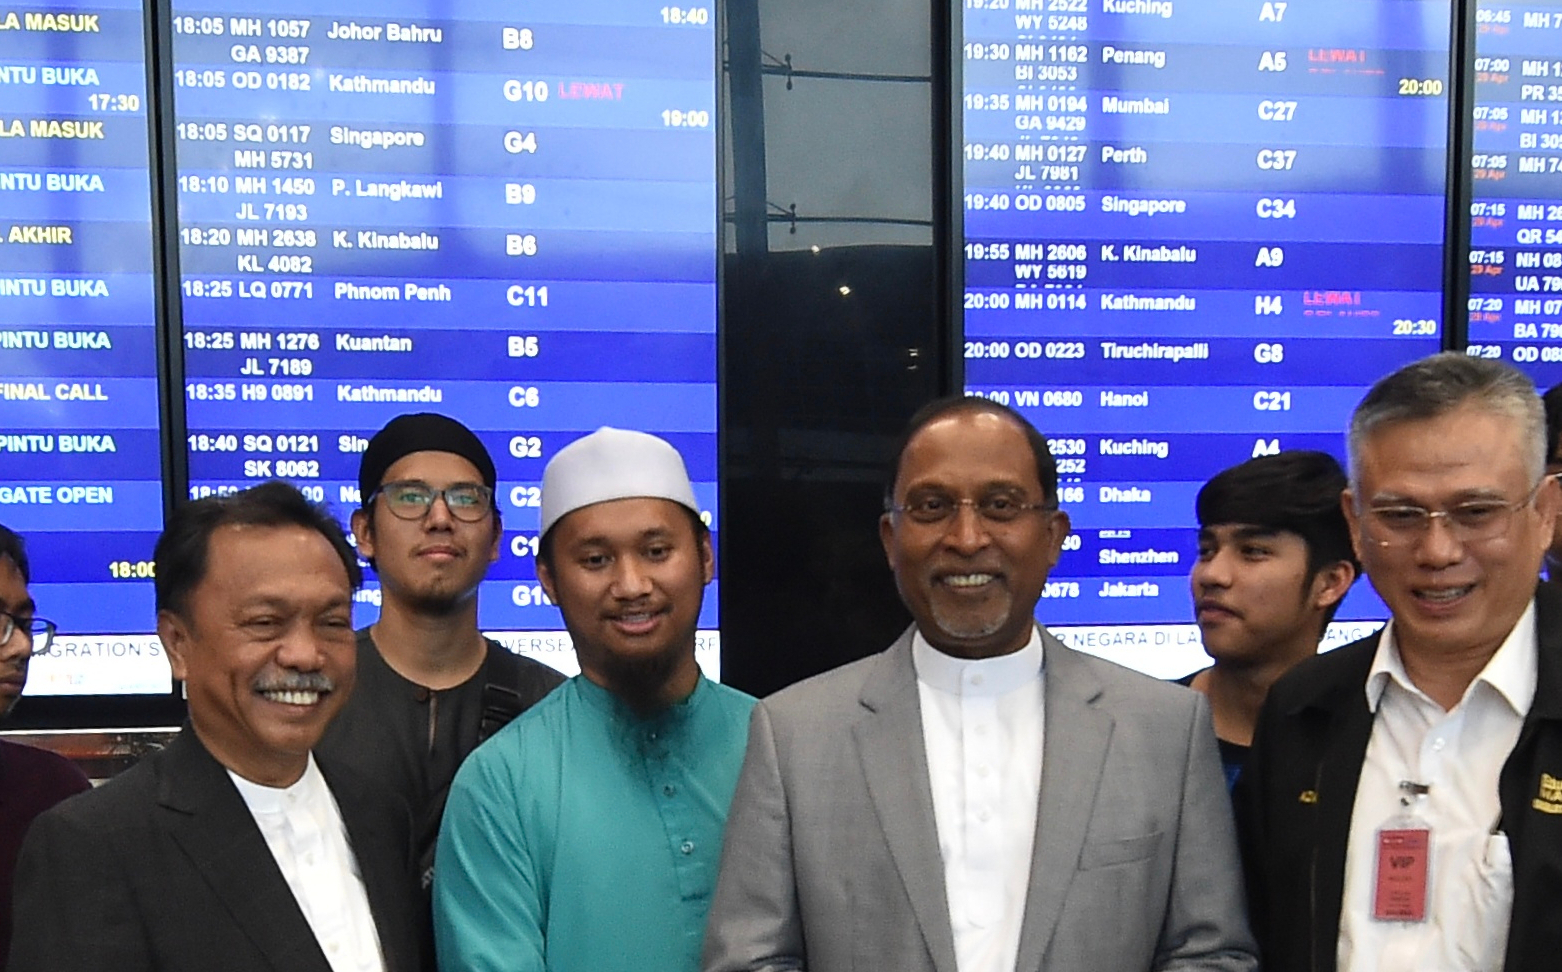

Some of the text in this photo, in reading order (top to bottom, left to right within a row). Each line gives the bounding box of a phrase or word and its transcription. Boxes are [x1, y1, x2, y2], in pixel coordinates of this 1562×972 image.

[25, 13, 99, 32] MASUK
[661, 7, 708, 24] 18:40
[174, 17, 533, 49] 18:05 MH 1057 Johor Bahru B8
[964, 43, 1165, 68] 19:30 MH 1162 Penang
[1475, 58, 1509, 72] 07:00
[1523, 61, 1548, 76] MH
[42, 68, 99, 85] BUKA
[175, 70, 225, 87] 18:05
[232, 72, 262, 88] OD
[267, 73, 310, 90] 0182
[329, 75, 434, 94] Kathmandu
[504, 80, 548, 101] G10
[1399, 79, 1442, 95] 20:00
[1522, 85, 1544, 100] PR
[89, 94, 139, 111] 17:30
[1103, 97, 1297, 120] Mumbai C27
[662, 110, 709, 127] 19:00
[333, 179, 535, 204] P. Langkawi B9
[964, 194, 1296, 218] 19:40 OD 0805 Singapore C34
[9, 227, 71, 243] AKHIR
[1516, 253, 1540, 267] NH
[335, 283, 547, 306] Phnom Penh C11
[336, 334, 538, 356] Kuantan B5
[964, 342, 1283, 363] 20:00 OD 0223 Tiruchirapalli G8
[1513, 347, 1538, 362] OD
[55, 384, 108, 400] CALL
[1101, 391, 1290, 410] Hanoi C21
[1100, 439, 1168, 458] Kuching
[57, 487, 112, 503] OPEN
[1100, 487, 1151, 502] Dhaka
[1099, 549, 1178, 563] Shenzhen
[1099, 582, 1158, 596] Jakarta
[1074, 631, 1171, 647] NEGARA DI
